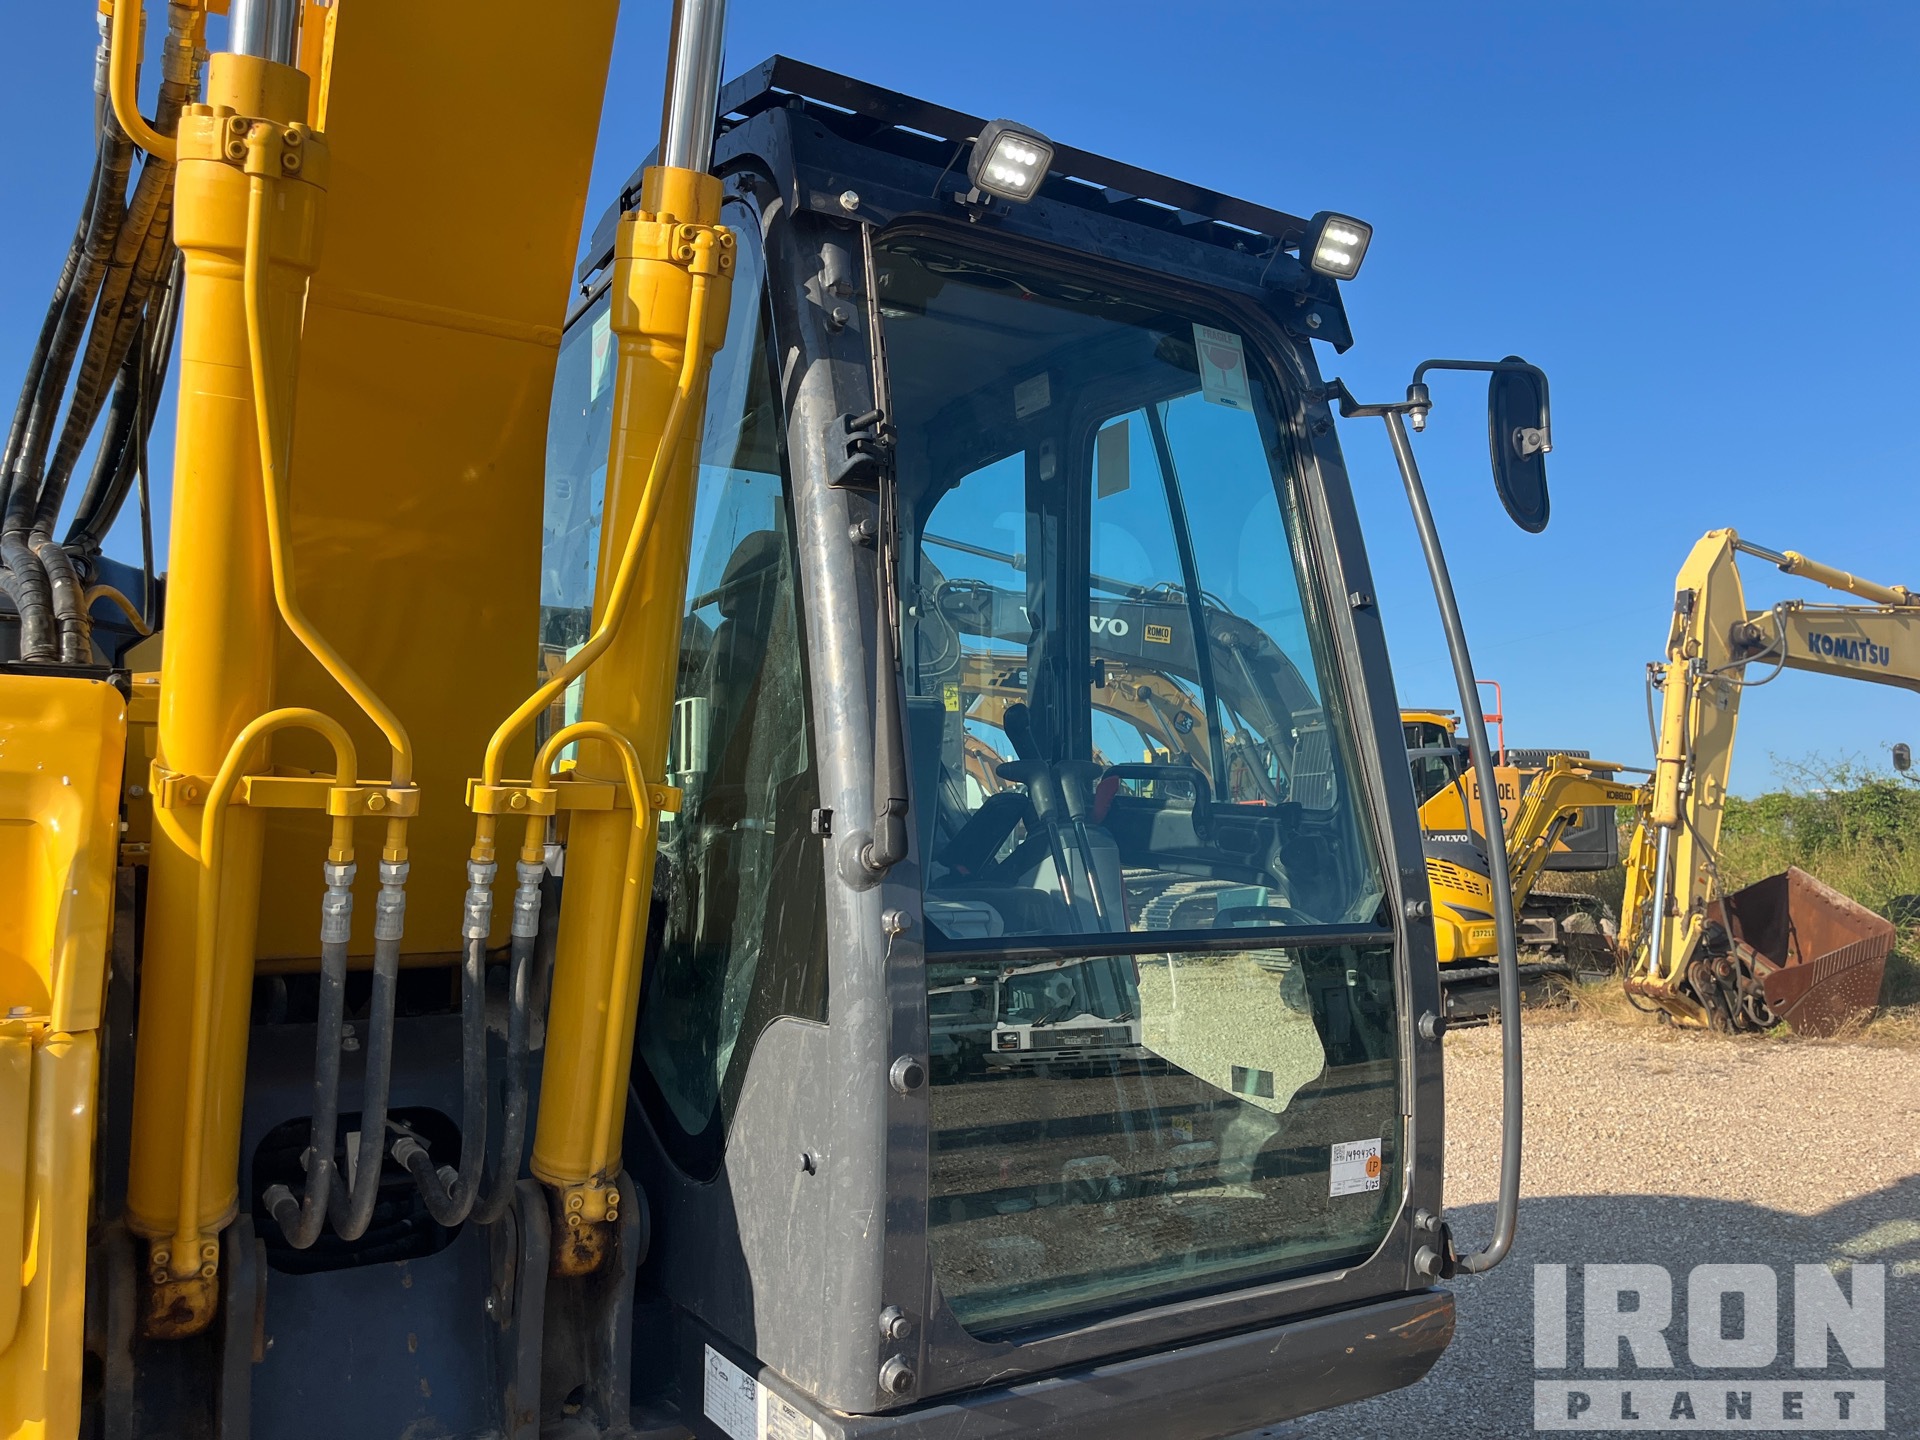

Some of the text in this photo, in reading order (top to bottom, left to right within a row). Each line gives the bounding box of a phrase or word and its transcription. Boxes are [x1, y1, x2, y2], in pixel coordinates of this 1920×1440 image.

[1202, 328, 1234, 345] FRAGILE
[1147, 625, 1169, 638] ROMCO
[1808, 632, 1889, 667] KOMATSU
[1368, 1161, 1379, 1172] IP
